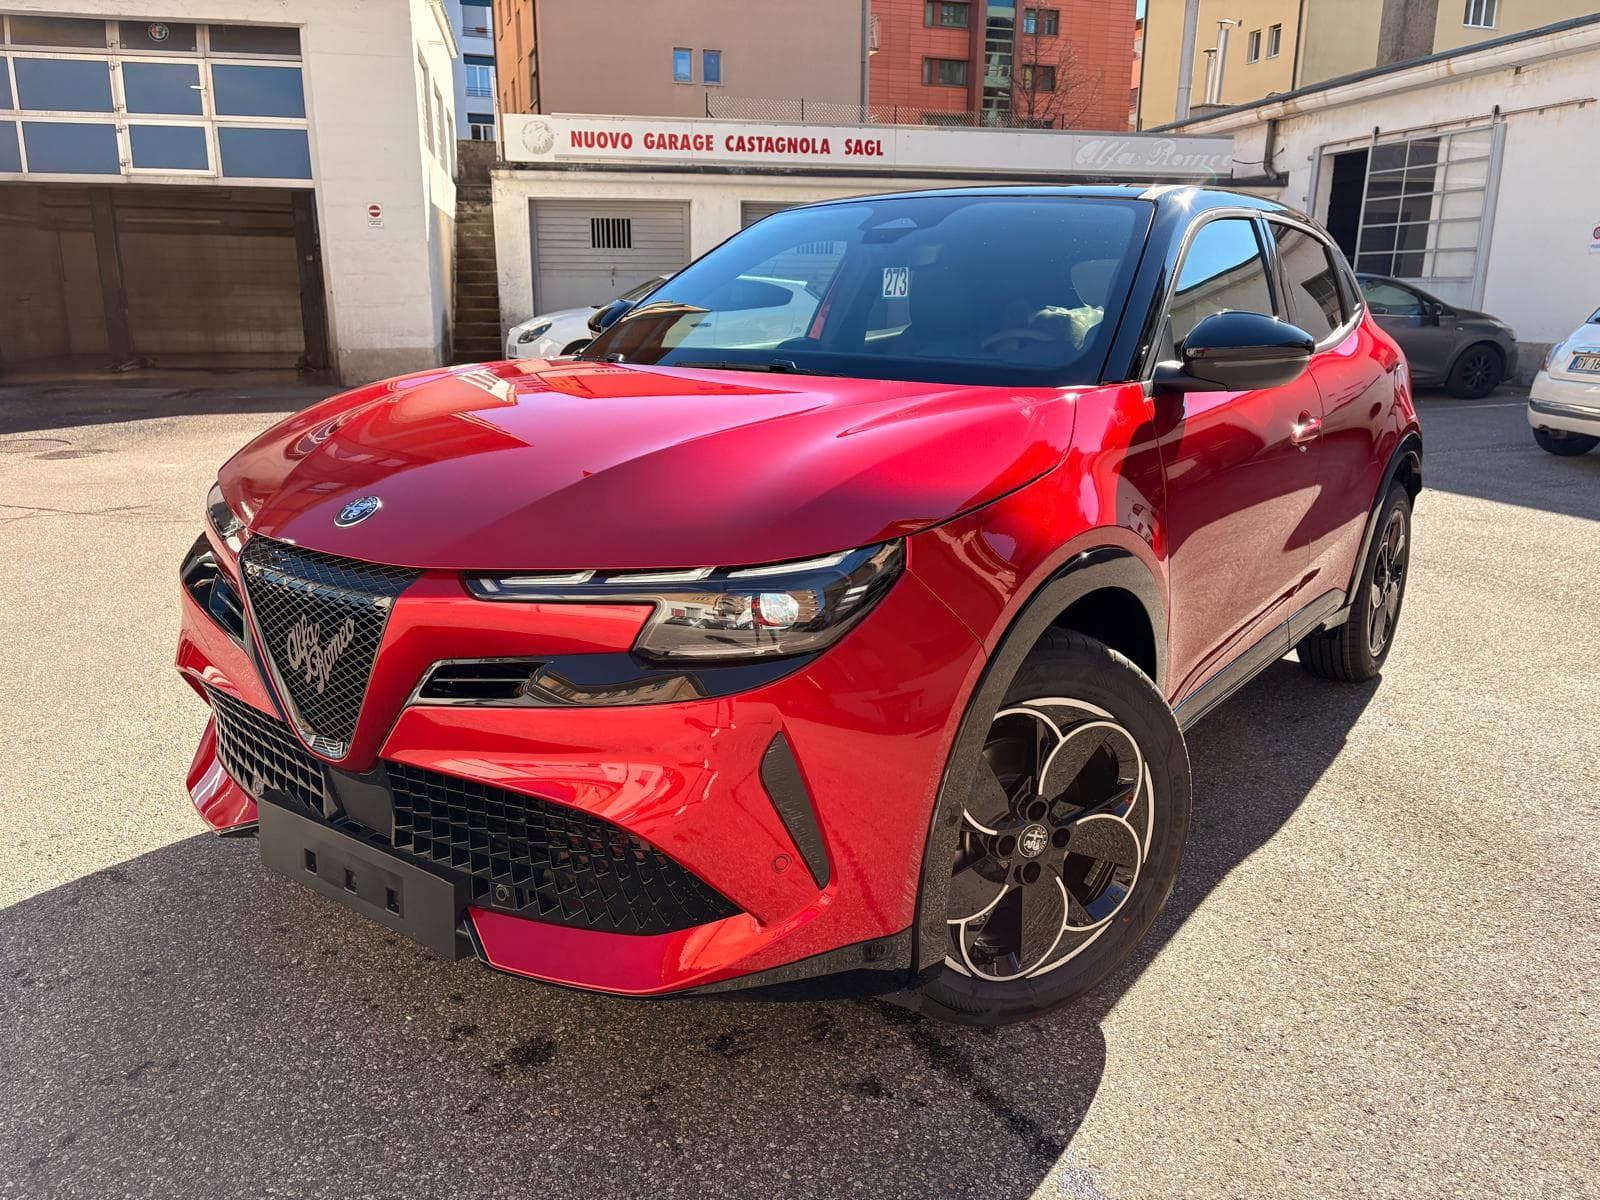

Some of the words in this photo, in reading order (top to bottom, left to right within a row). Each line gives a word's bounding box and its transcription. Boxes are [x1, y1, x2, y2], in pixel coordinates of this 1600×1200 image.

[570, 130, 633, 150] NUOVO
[643, 132, 714, 151] GARAGE
[724, 135, 831, 154] CASTAGNOLA
[844, 138, 884, 157] SAGL
[1075, 139, 1137, 169] Alfa
[884, 268, 907, 296] 273
[287, 613, 320, 671] Alfa
[305, 617, 355, 694] Romeo
